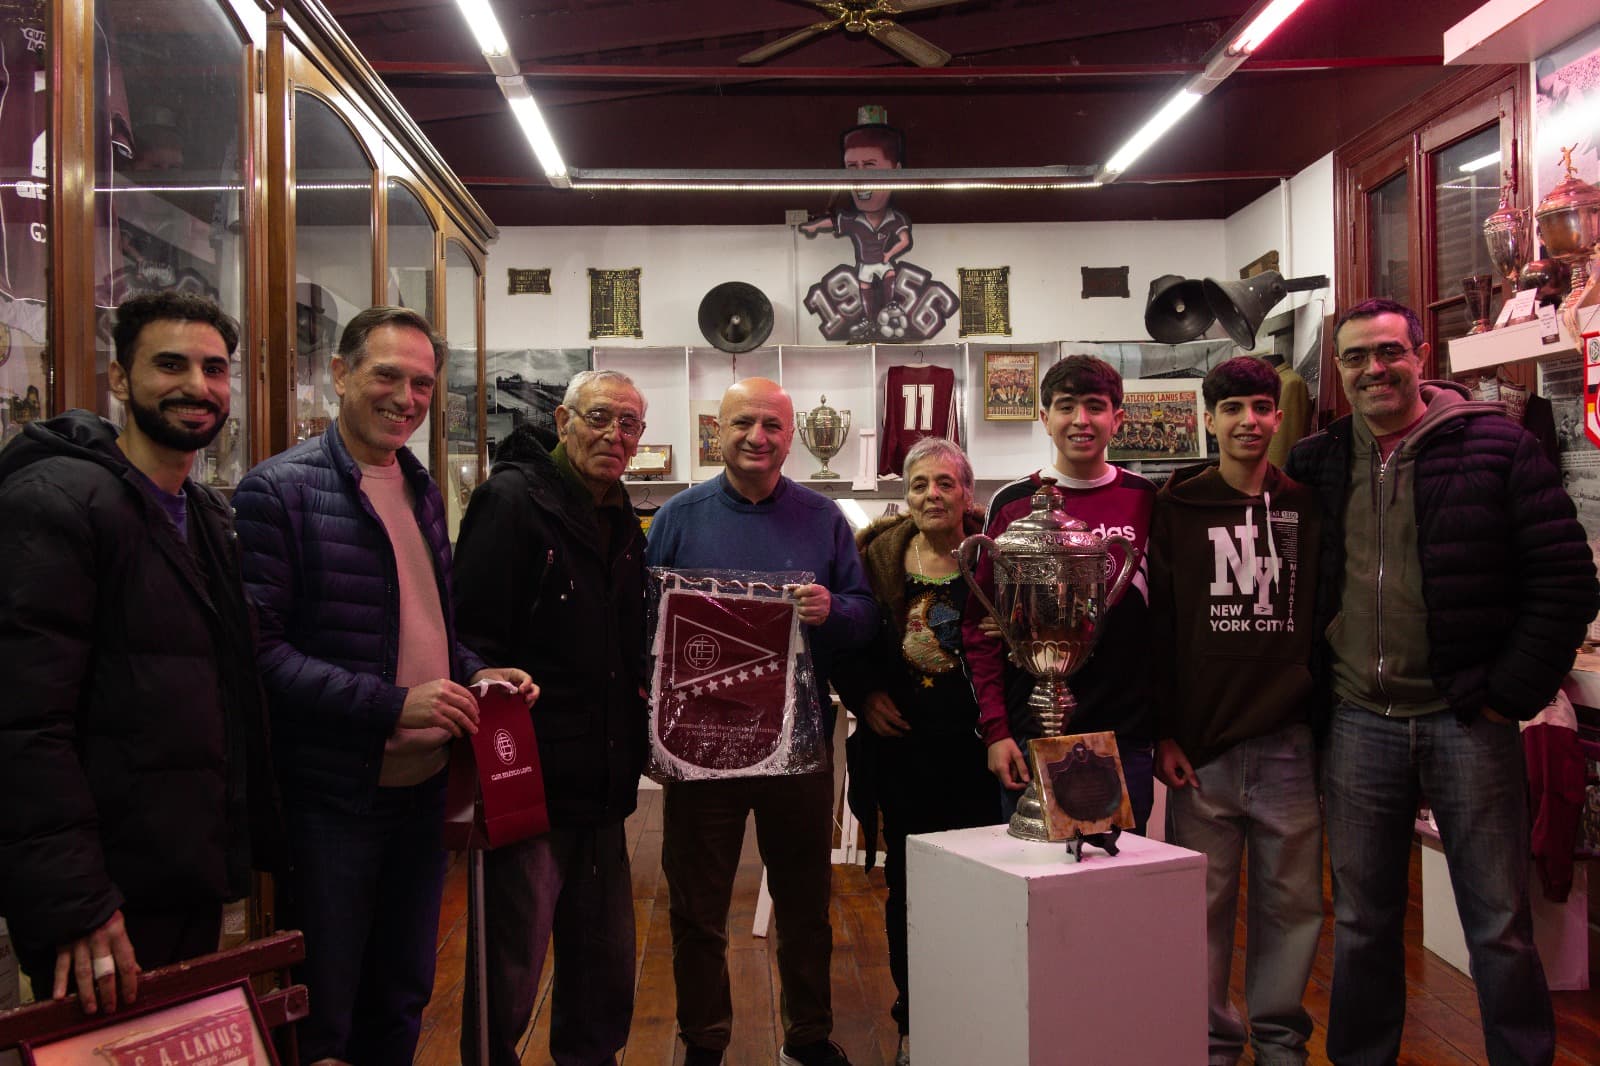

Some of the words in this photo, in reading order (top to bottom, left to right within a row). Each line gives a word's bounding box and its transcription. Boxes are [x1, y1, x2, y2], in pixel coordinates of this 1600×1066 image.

[808, 267, 954, 338] 1956
[902, 384, 935, 430] 11
[1091, 523, 1136, 541] das
[1207, 525, 1283, 616] NY
[1210, 604, 1244, 617] NEW
[1286, 562, 1298, 633] MANHATTAN
[1210, 619, 1251, 632] YORK
[1255, 619, 1285, 632] CITY
[180, 1022, 243, 1061] LANUS
